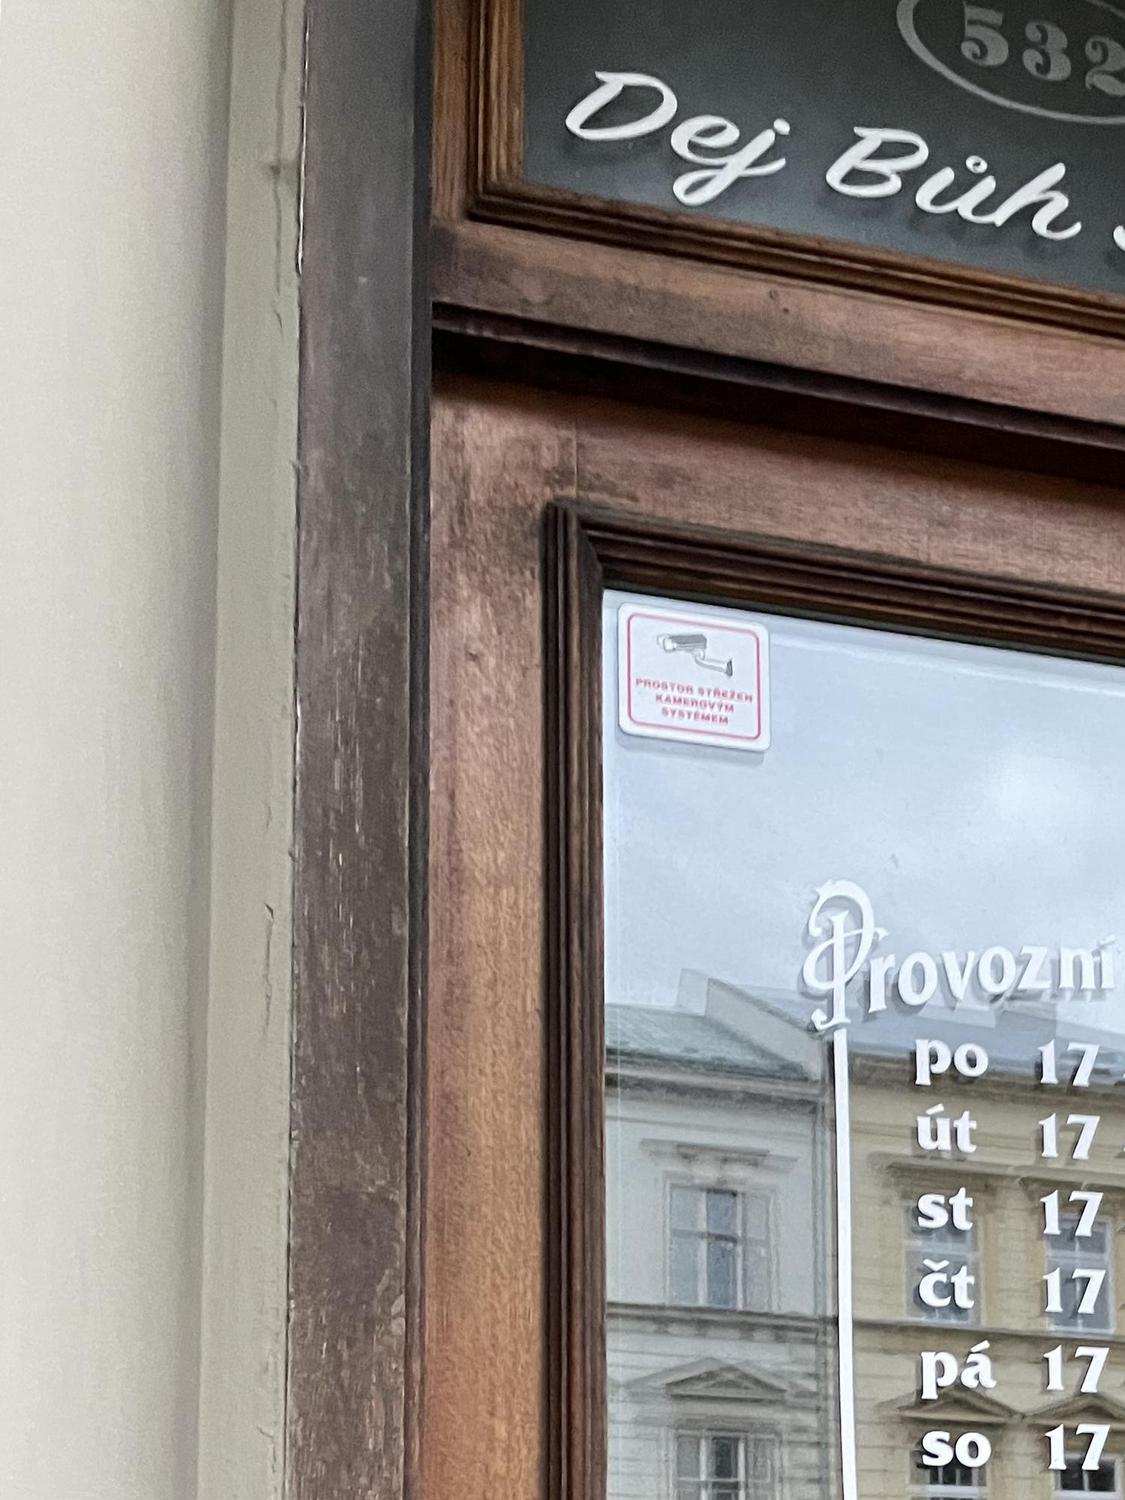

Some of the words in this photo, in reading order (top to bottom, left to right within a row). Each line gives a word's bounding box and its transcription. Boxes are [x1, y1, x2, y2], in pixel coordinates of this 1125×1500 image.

[564, 70, 791, 205] Dej
[825, 126, 1081, 240] Bůh
[636, 678, 693, 695] PROSTOR
[698, 686, 753, 703] STŘEŽEN
[656, 694, 734, 713] KAMEROVÝM
[802, 879, 1117, 1031] Provozní
[915, 1038, 988, 1086] po
[1037, 1038, 1101, 1087] 17
[916, 1104, 977, 1153] út
[1038, 1112, 1101, 1160] 17
[918, 1187, 973, 1230] st
[1040, 1191, 1103, 1236] 17
[919, 1259, 974, 1309] čt
[1042, 1267, 1107, 1313] 17
[921, 1341, 996, 1399] pá
[1043, 1345, 1109, 1393] 17
[922, 1431, 991, 1467] so
[1046, 1424, 1110, 1471] 17
